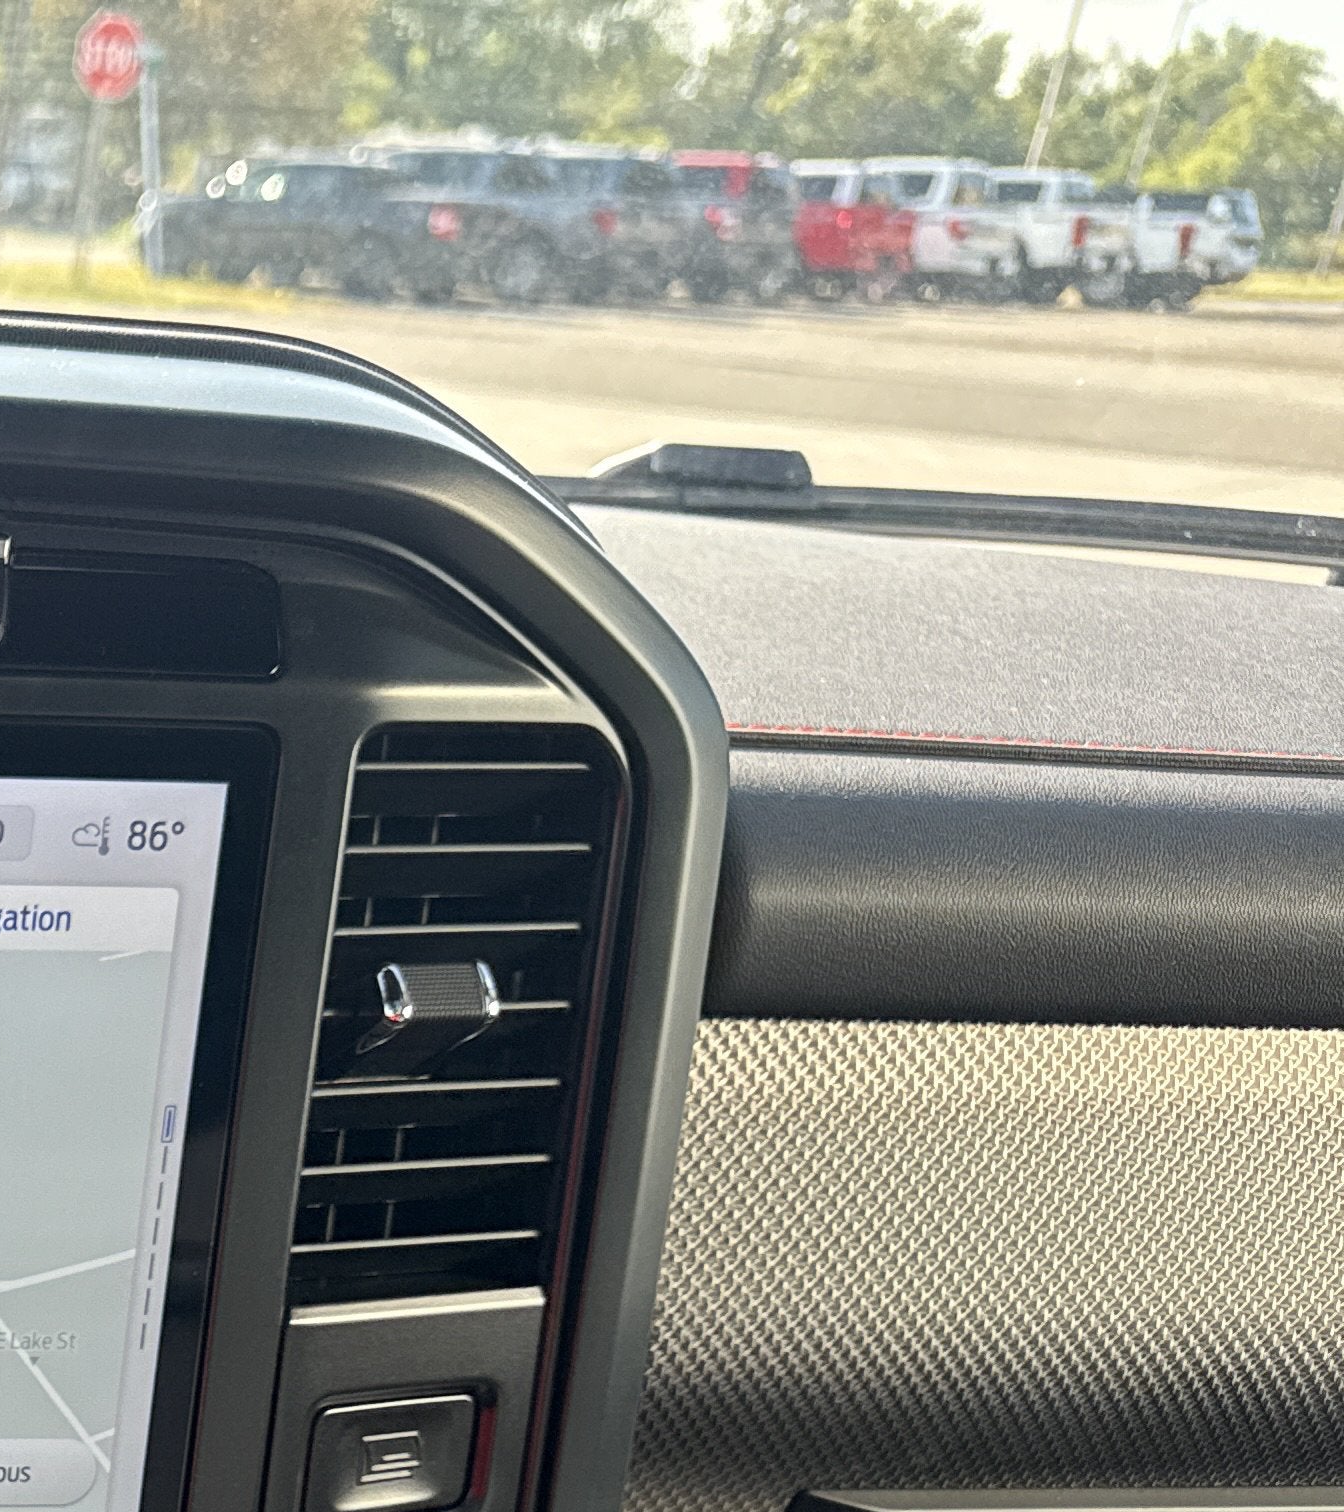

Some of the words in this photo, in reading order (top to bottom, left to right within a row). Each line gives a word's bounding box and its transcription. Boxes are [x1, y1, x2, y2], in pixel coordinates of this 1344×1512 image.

[126, 820, 186, 851] 86°
[9, 1332, 54, 1350] Lake
[56, 1331, 77, 1350] St
